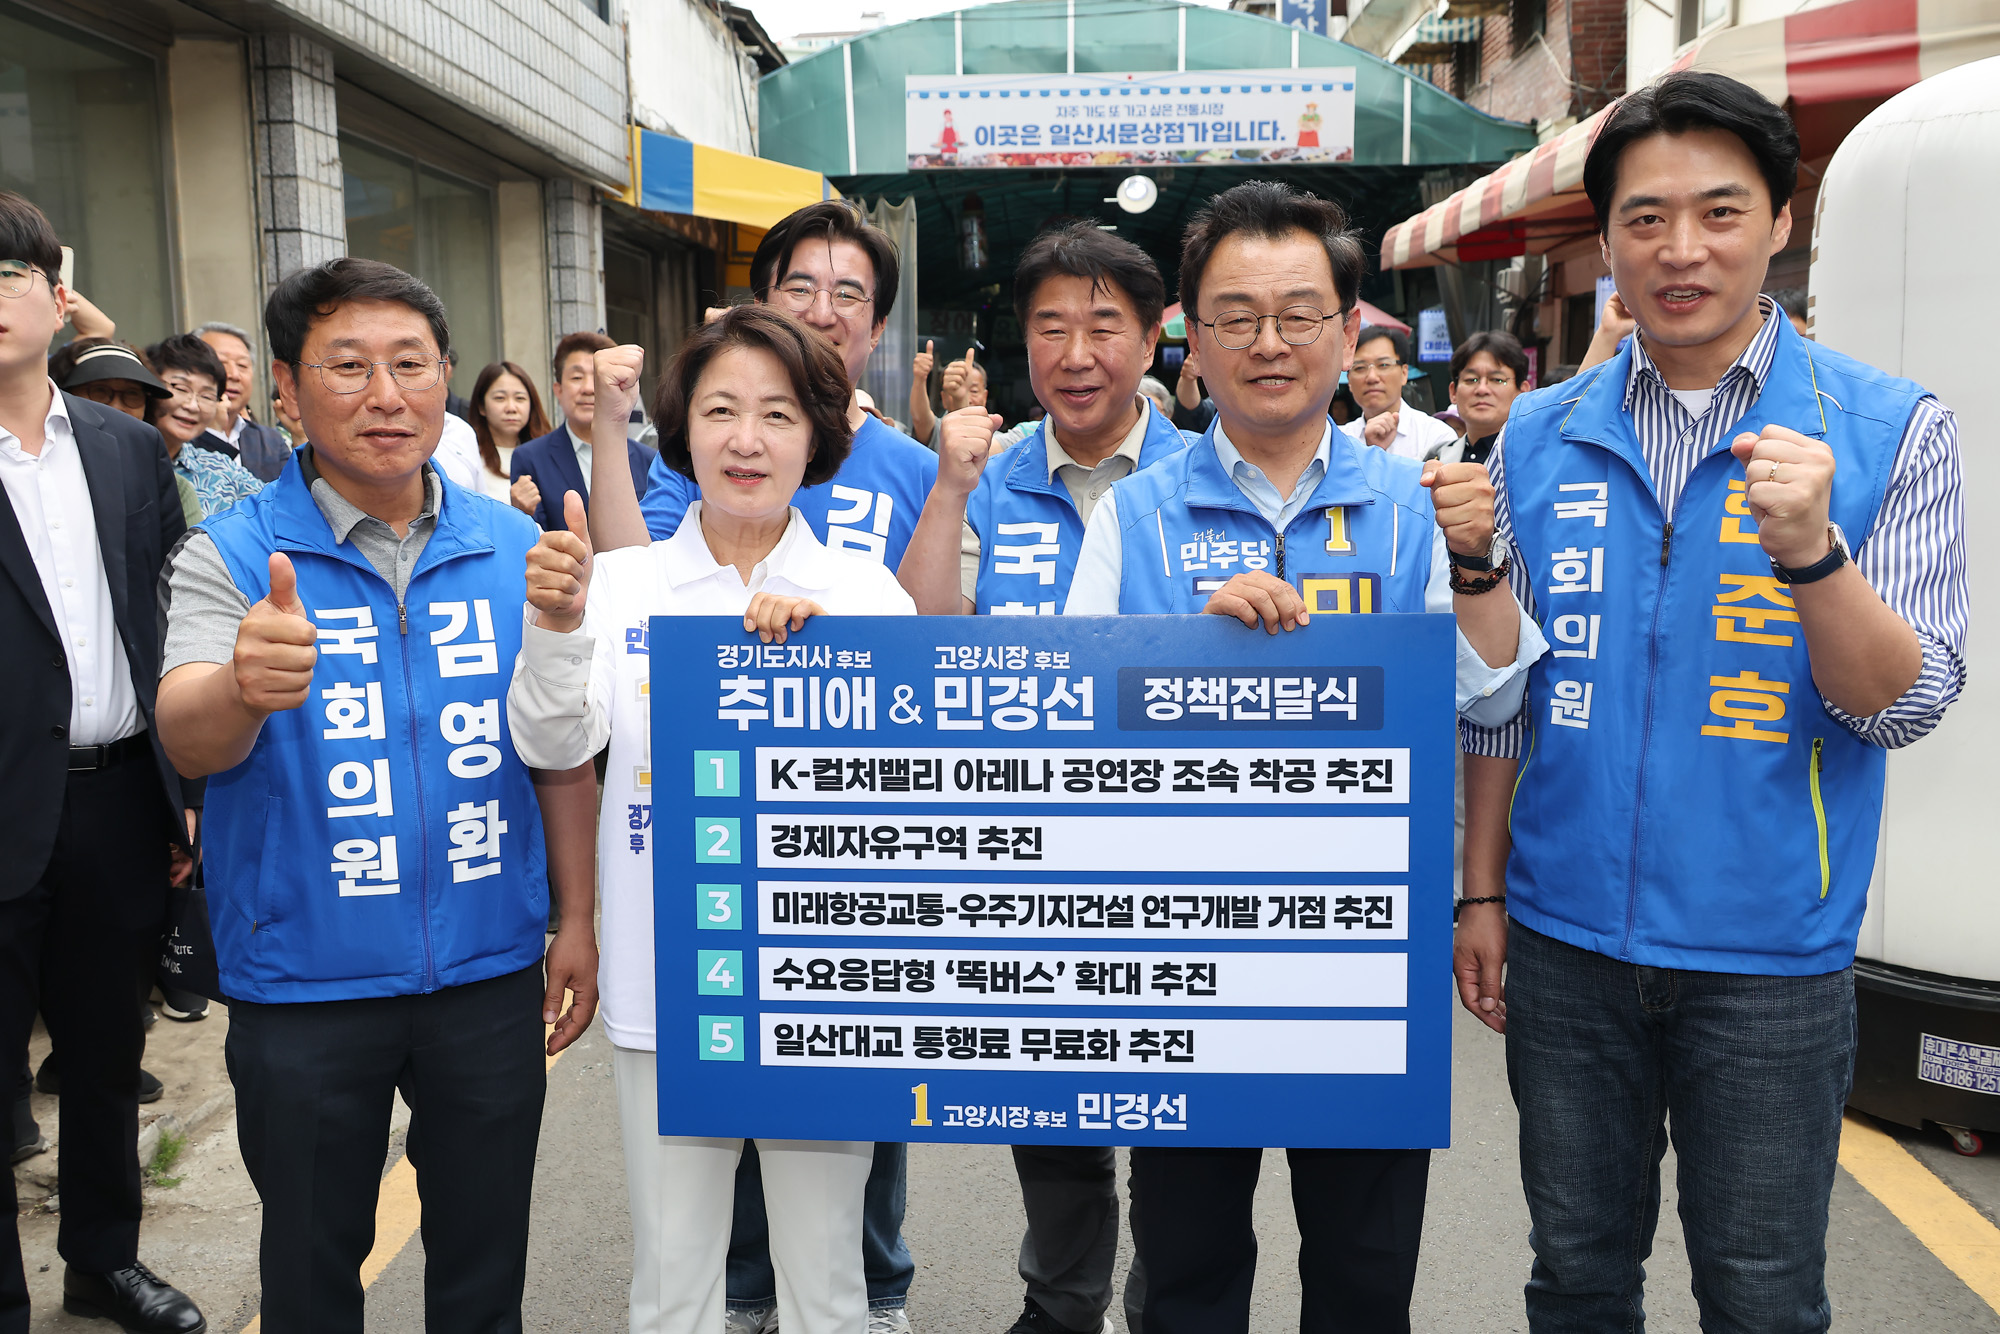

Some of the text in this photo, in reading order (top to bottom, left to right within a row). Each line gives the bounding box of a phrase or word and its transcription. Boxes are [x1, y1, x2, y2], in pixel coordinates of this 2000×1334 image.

[1056, 103, 1224, 118] 자주 가도 또 가고 싶은 전통시장
[974, 120, 1286, 146] 이곳은 일산서문상점가입니다.
[826, 484, 894, 565] 김
[1192, 528, 1226, 544] 더불어
[1324, 506, 1354, 555] 1
[993, 522, 1061, 615] 국
[1180, 540, 1271, 572] 민주당
[1548, 480, 1610, 730] 국회의원
[717, 645, 872, 669] 경기도지사 후보
[934, 646, 1071, 670] 고양시장 후보
[718, 674, 1094, 731] 추미애 & 민경선
[1144, 677, 1357, 721] 정책전달식
[314, 605, 401, 897] 국회의원
[428, 598, 508, 885] 김영환
[709, 758, 1393, 794] 1 K-컬처밸리 아레나 공연장 조속 착공 추진
[705, 824, 1043, 861] 2 경제자유구역 추진
[707, 891, 1393, 930] 3 미래항공교통-우주기지건설 연구개발 거점 추진
[706, 957, 735, 990] 4
[772, 957, 935, 993] 수요응답형
[1075, 961, 1141, 996] 확대
[1151, 961, 1217, 996] 추진
[709, 1022, 1194, 1063] 5 일산대교 통행료 무료화 추진
[910, 1082, 1188, 1131] 1 고양시장 후보 민경선
